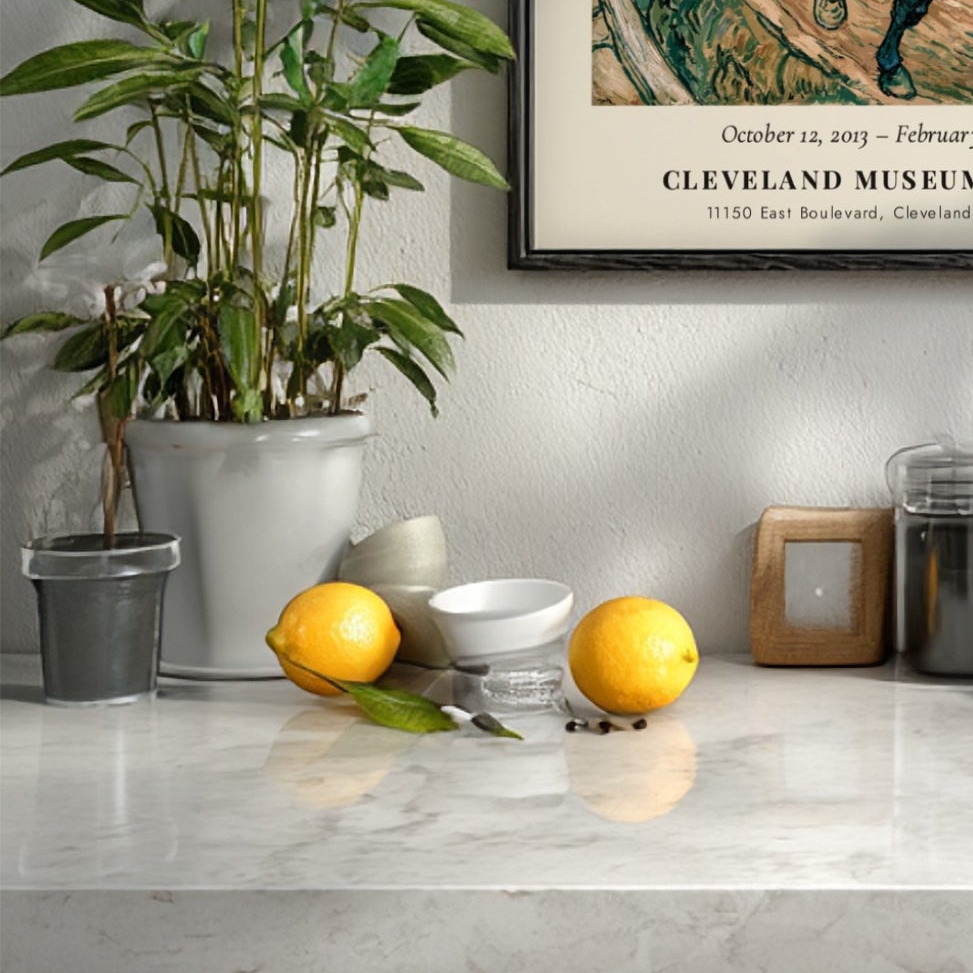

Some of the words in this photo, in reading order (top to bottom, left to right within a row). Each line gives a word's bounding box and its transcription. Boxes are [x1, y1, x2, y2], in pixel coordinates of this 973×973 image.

[721, 122, 796, 144] October
[799, 130, 823, 148] 12,
[829, 130, 869, 150] 2013
[662, 169, 843, 192] CLEVELAND
[706, 205, 753, 220] 11150
[760, 205, 792, 220] East
[800, 204, 884, 222] Boulevard,
[893, 204, 971, 220] Cleveland
